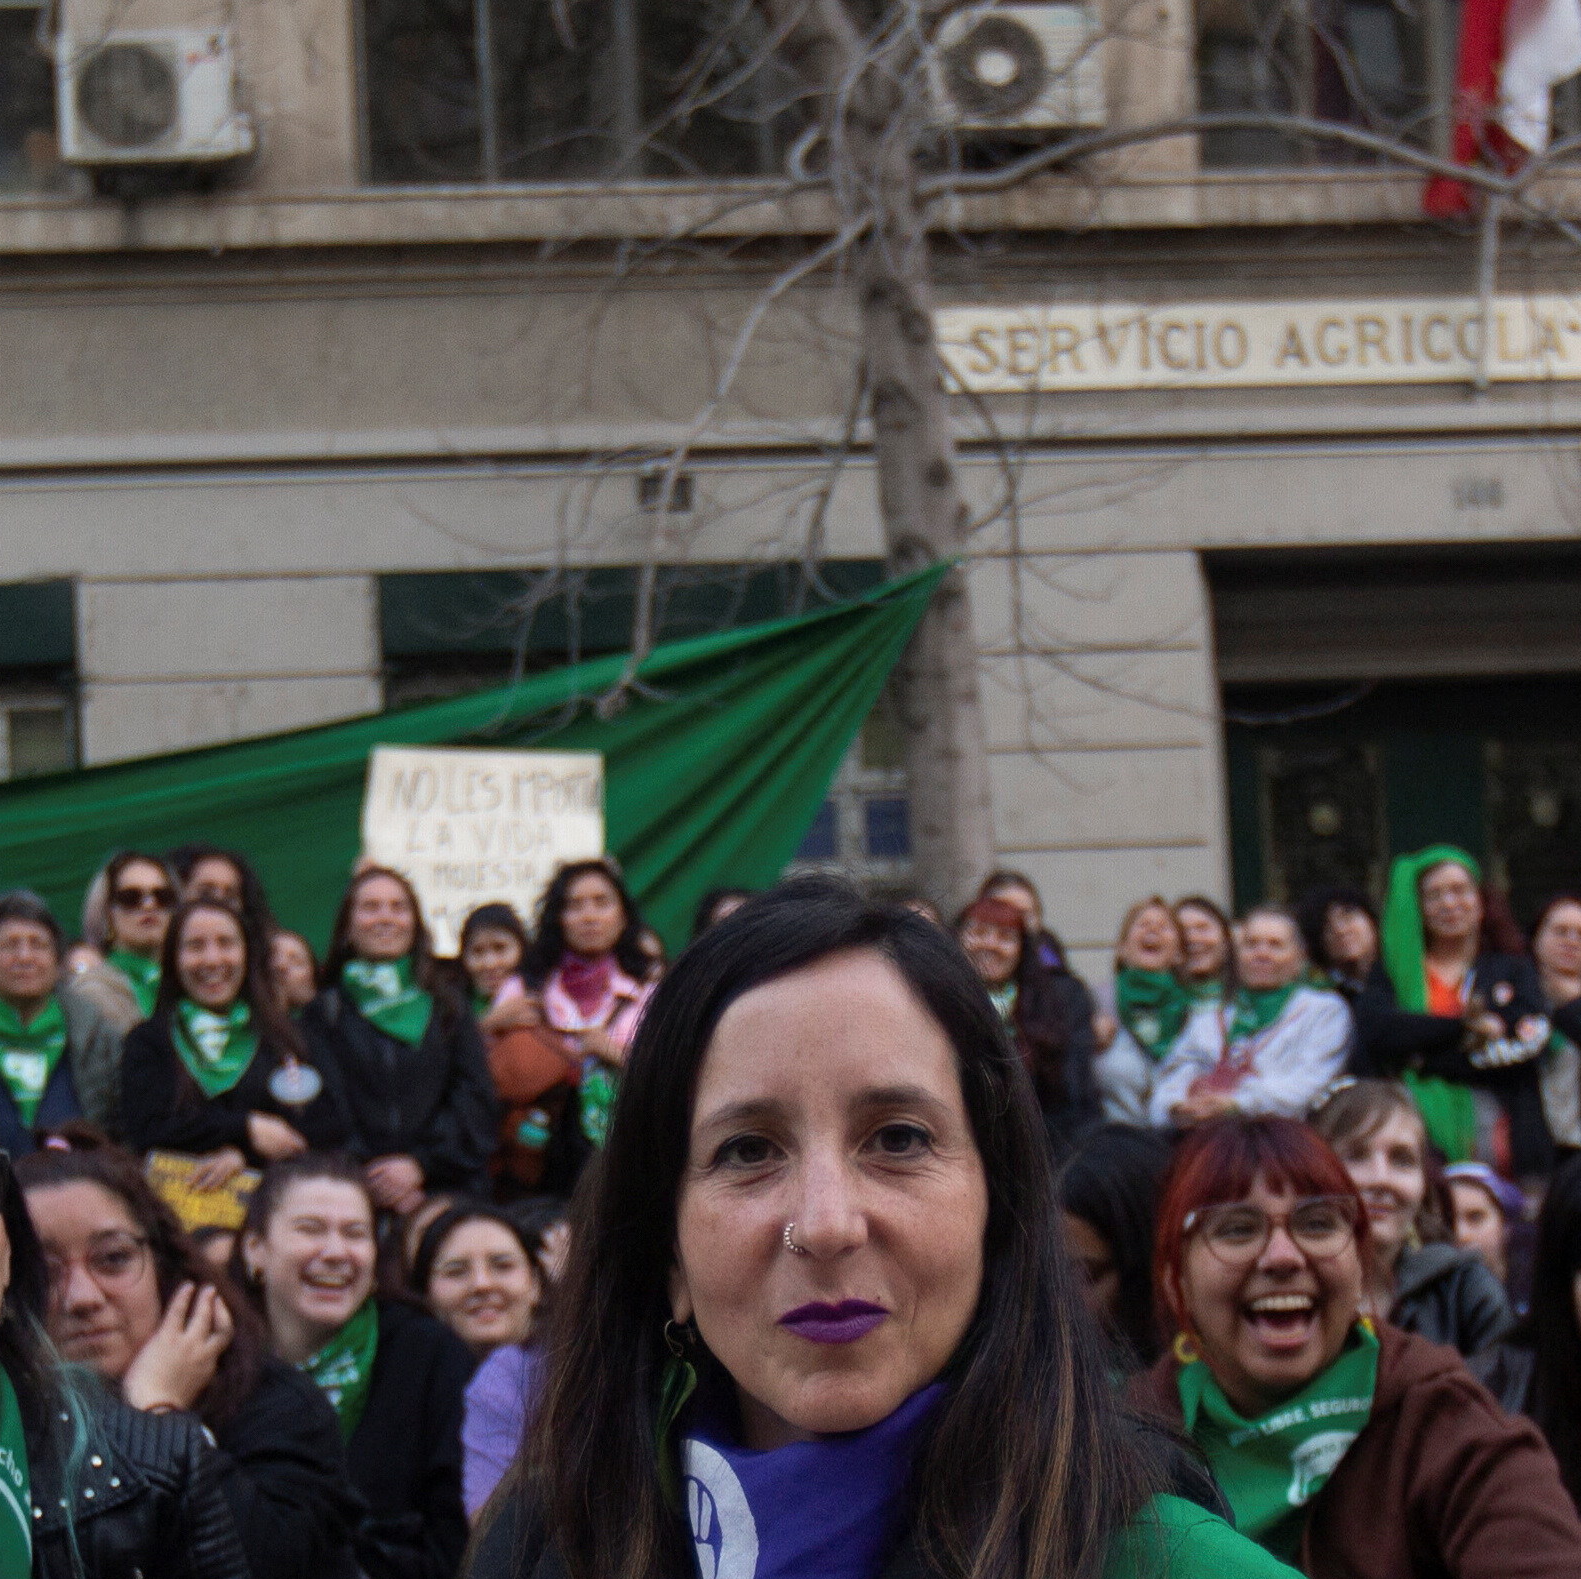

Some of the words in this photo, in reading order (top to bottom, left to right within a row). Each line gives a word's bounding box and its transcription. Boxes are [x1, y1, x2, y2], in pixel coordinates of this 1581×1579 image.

[968, 319, 1249, 377] SERVICIO
[1276, 311, 1566, 367] AGRICOLA
[387, 764, 440, 815] NO
[405, 820, 454, 854] LA
[469, 819, 556, 854] VIDA
